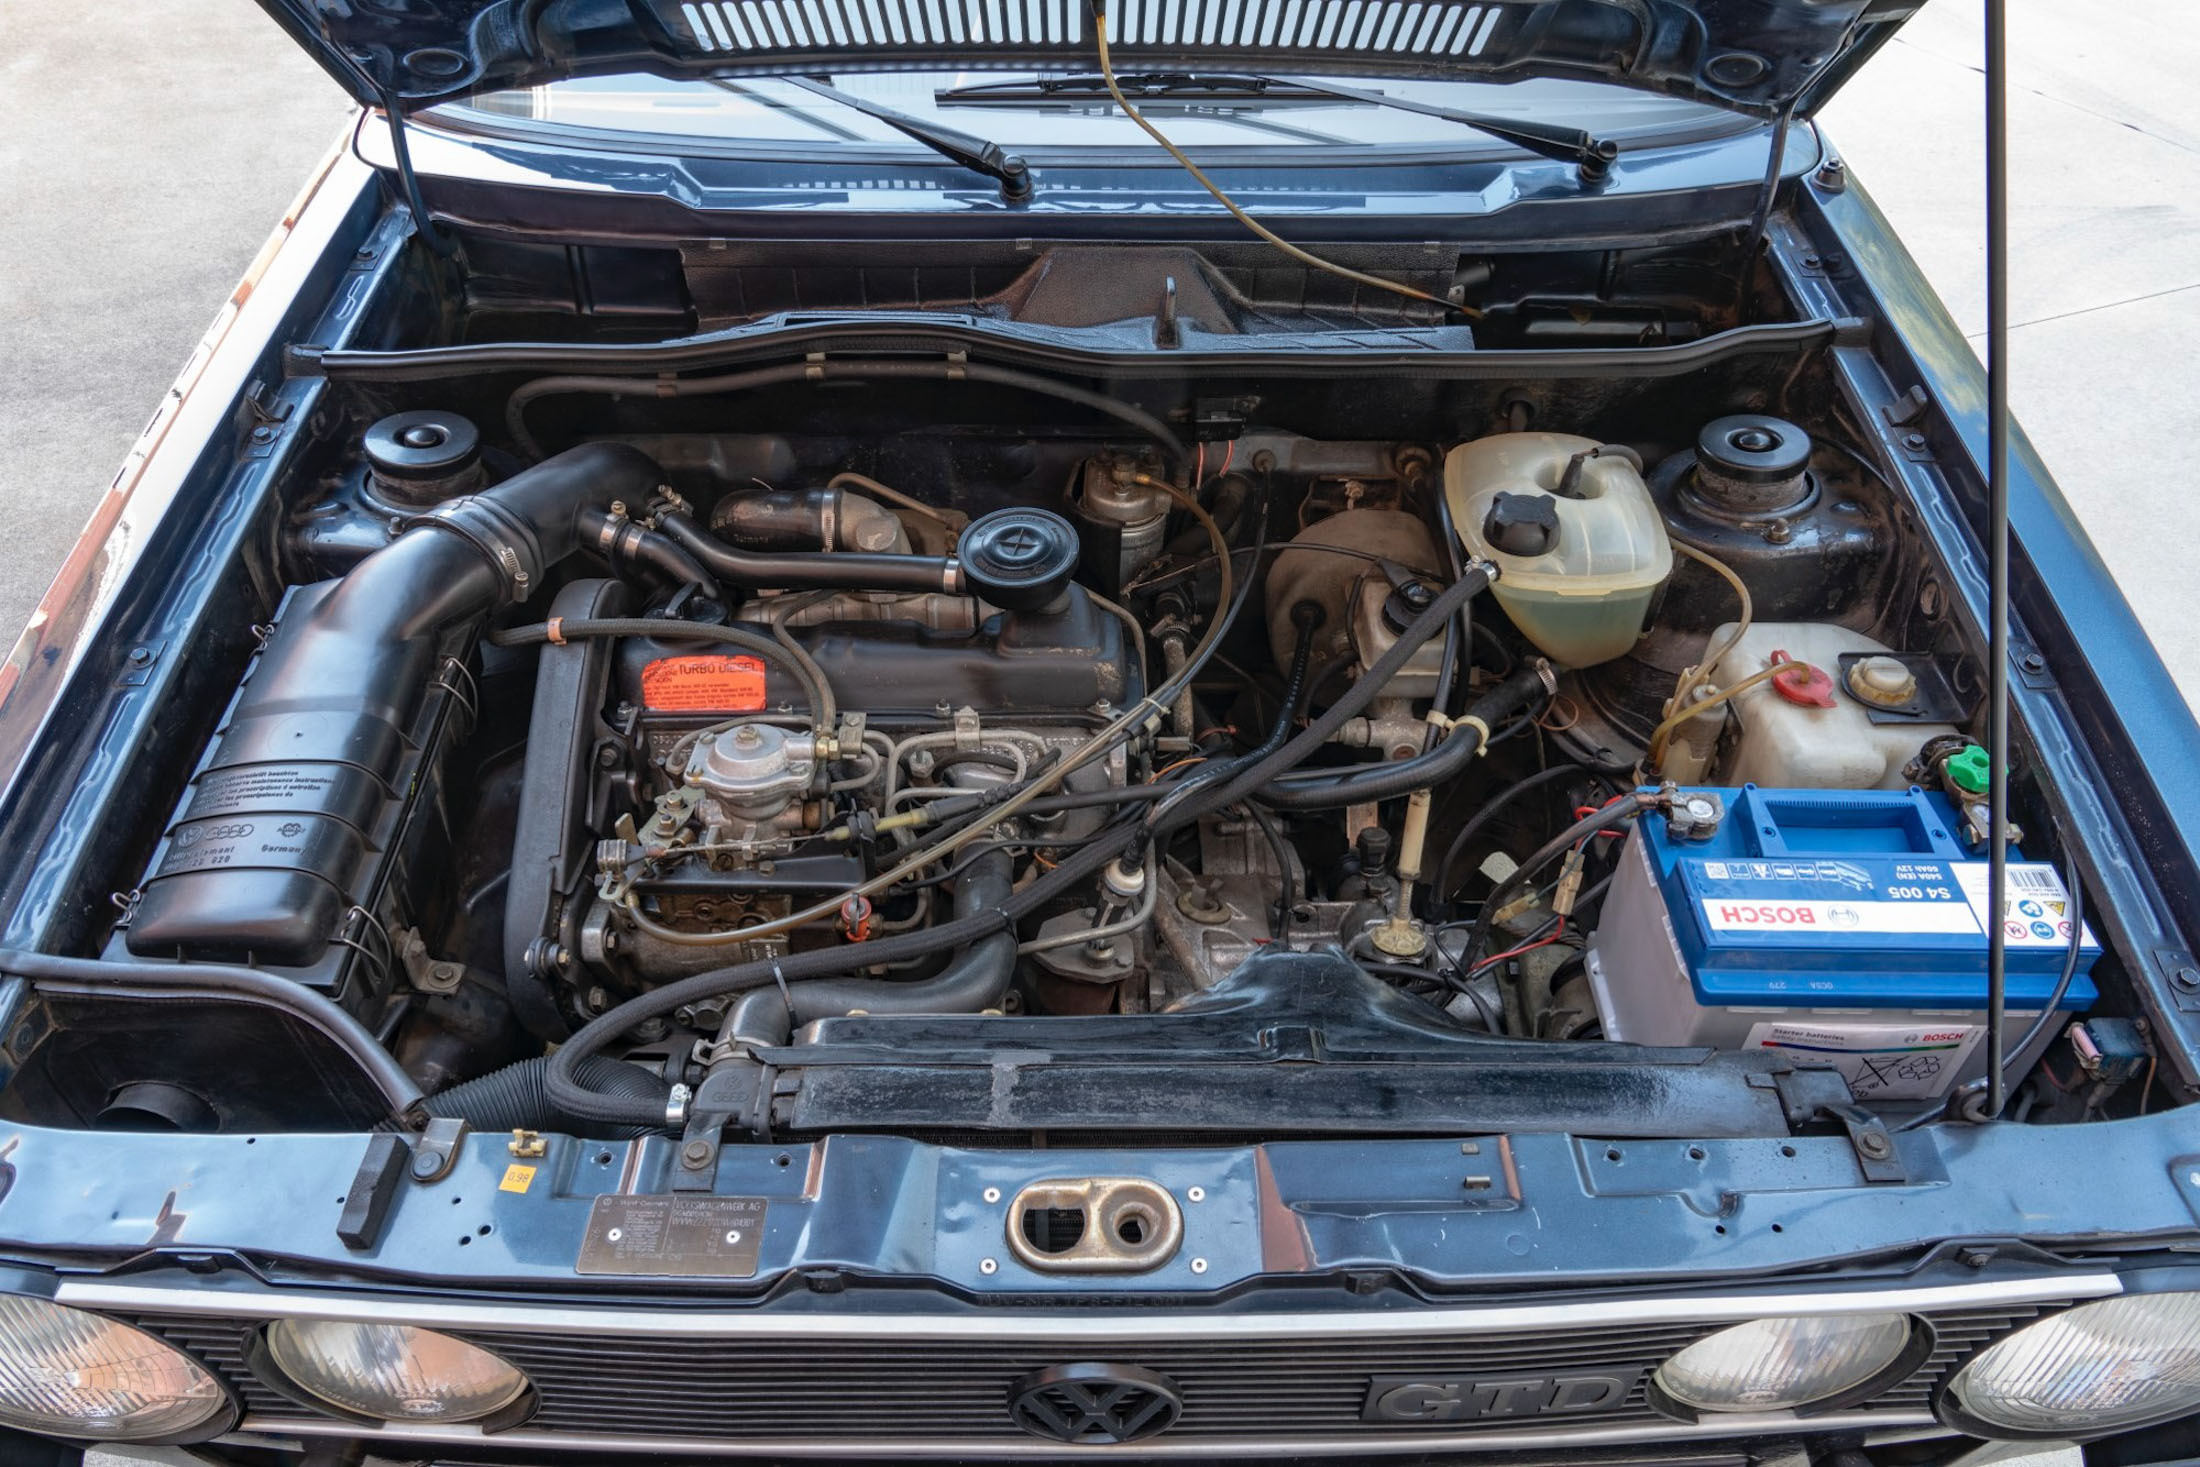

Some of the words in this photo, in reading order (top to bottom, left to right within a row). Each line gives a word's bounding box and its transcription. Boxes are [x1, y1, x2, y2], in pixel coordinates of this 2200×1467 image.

[679, 663, 715, 675] TURBO
[260, 843, 306, 856] Germany
[1887, 885, 1924, 899] 005
[1925, 886, 1952, 899] S4
[1720, 906, 1816, 925] BOSCH
[1773, 1027, 1804, 1038] Starter
[1806, 1031, 1846, 1042] batteries
[1922, 1032, 1964, 1043] BOSCH
[747, 1201, 761, 1212] AG
[1375, 1375, 1627, 1421] GTD
